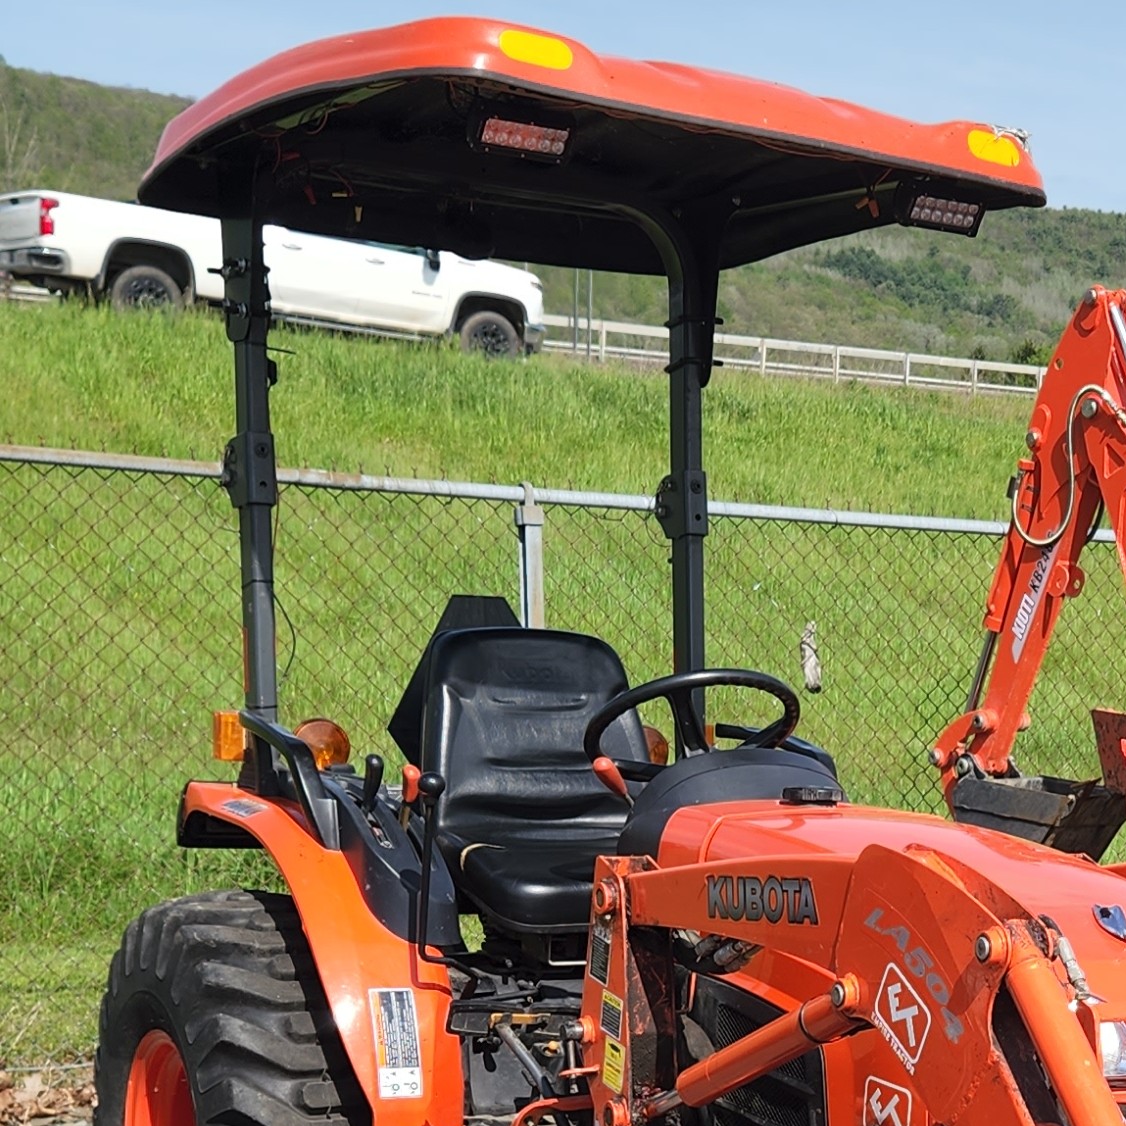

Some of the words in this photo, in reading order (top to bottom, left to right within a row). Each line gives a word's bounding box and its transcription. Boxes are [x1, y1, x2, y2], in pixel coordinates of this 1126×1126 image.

[705, 874, 820, 927] KUBOTA
[864, 907, 965, 1044] LA504
[871, 1010, 891, 1043] EMPIRE
[889, 1038, 916, 1076] TRACTOR
